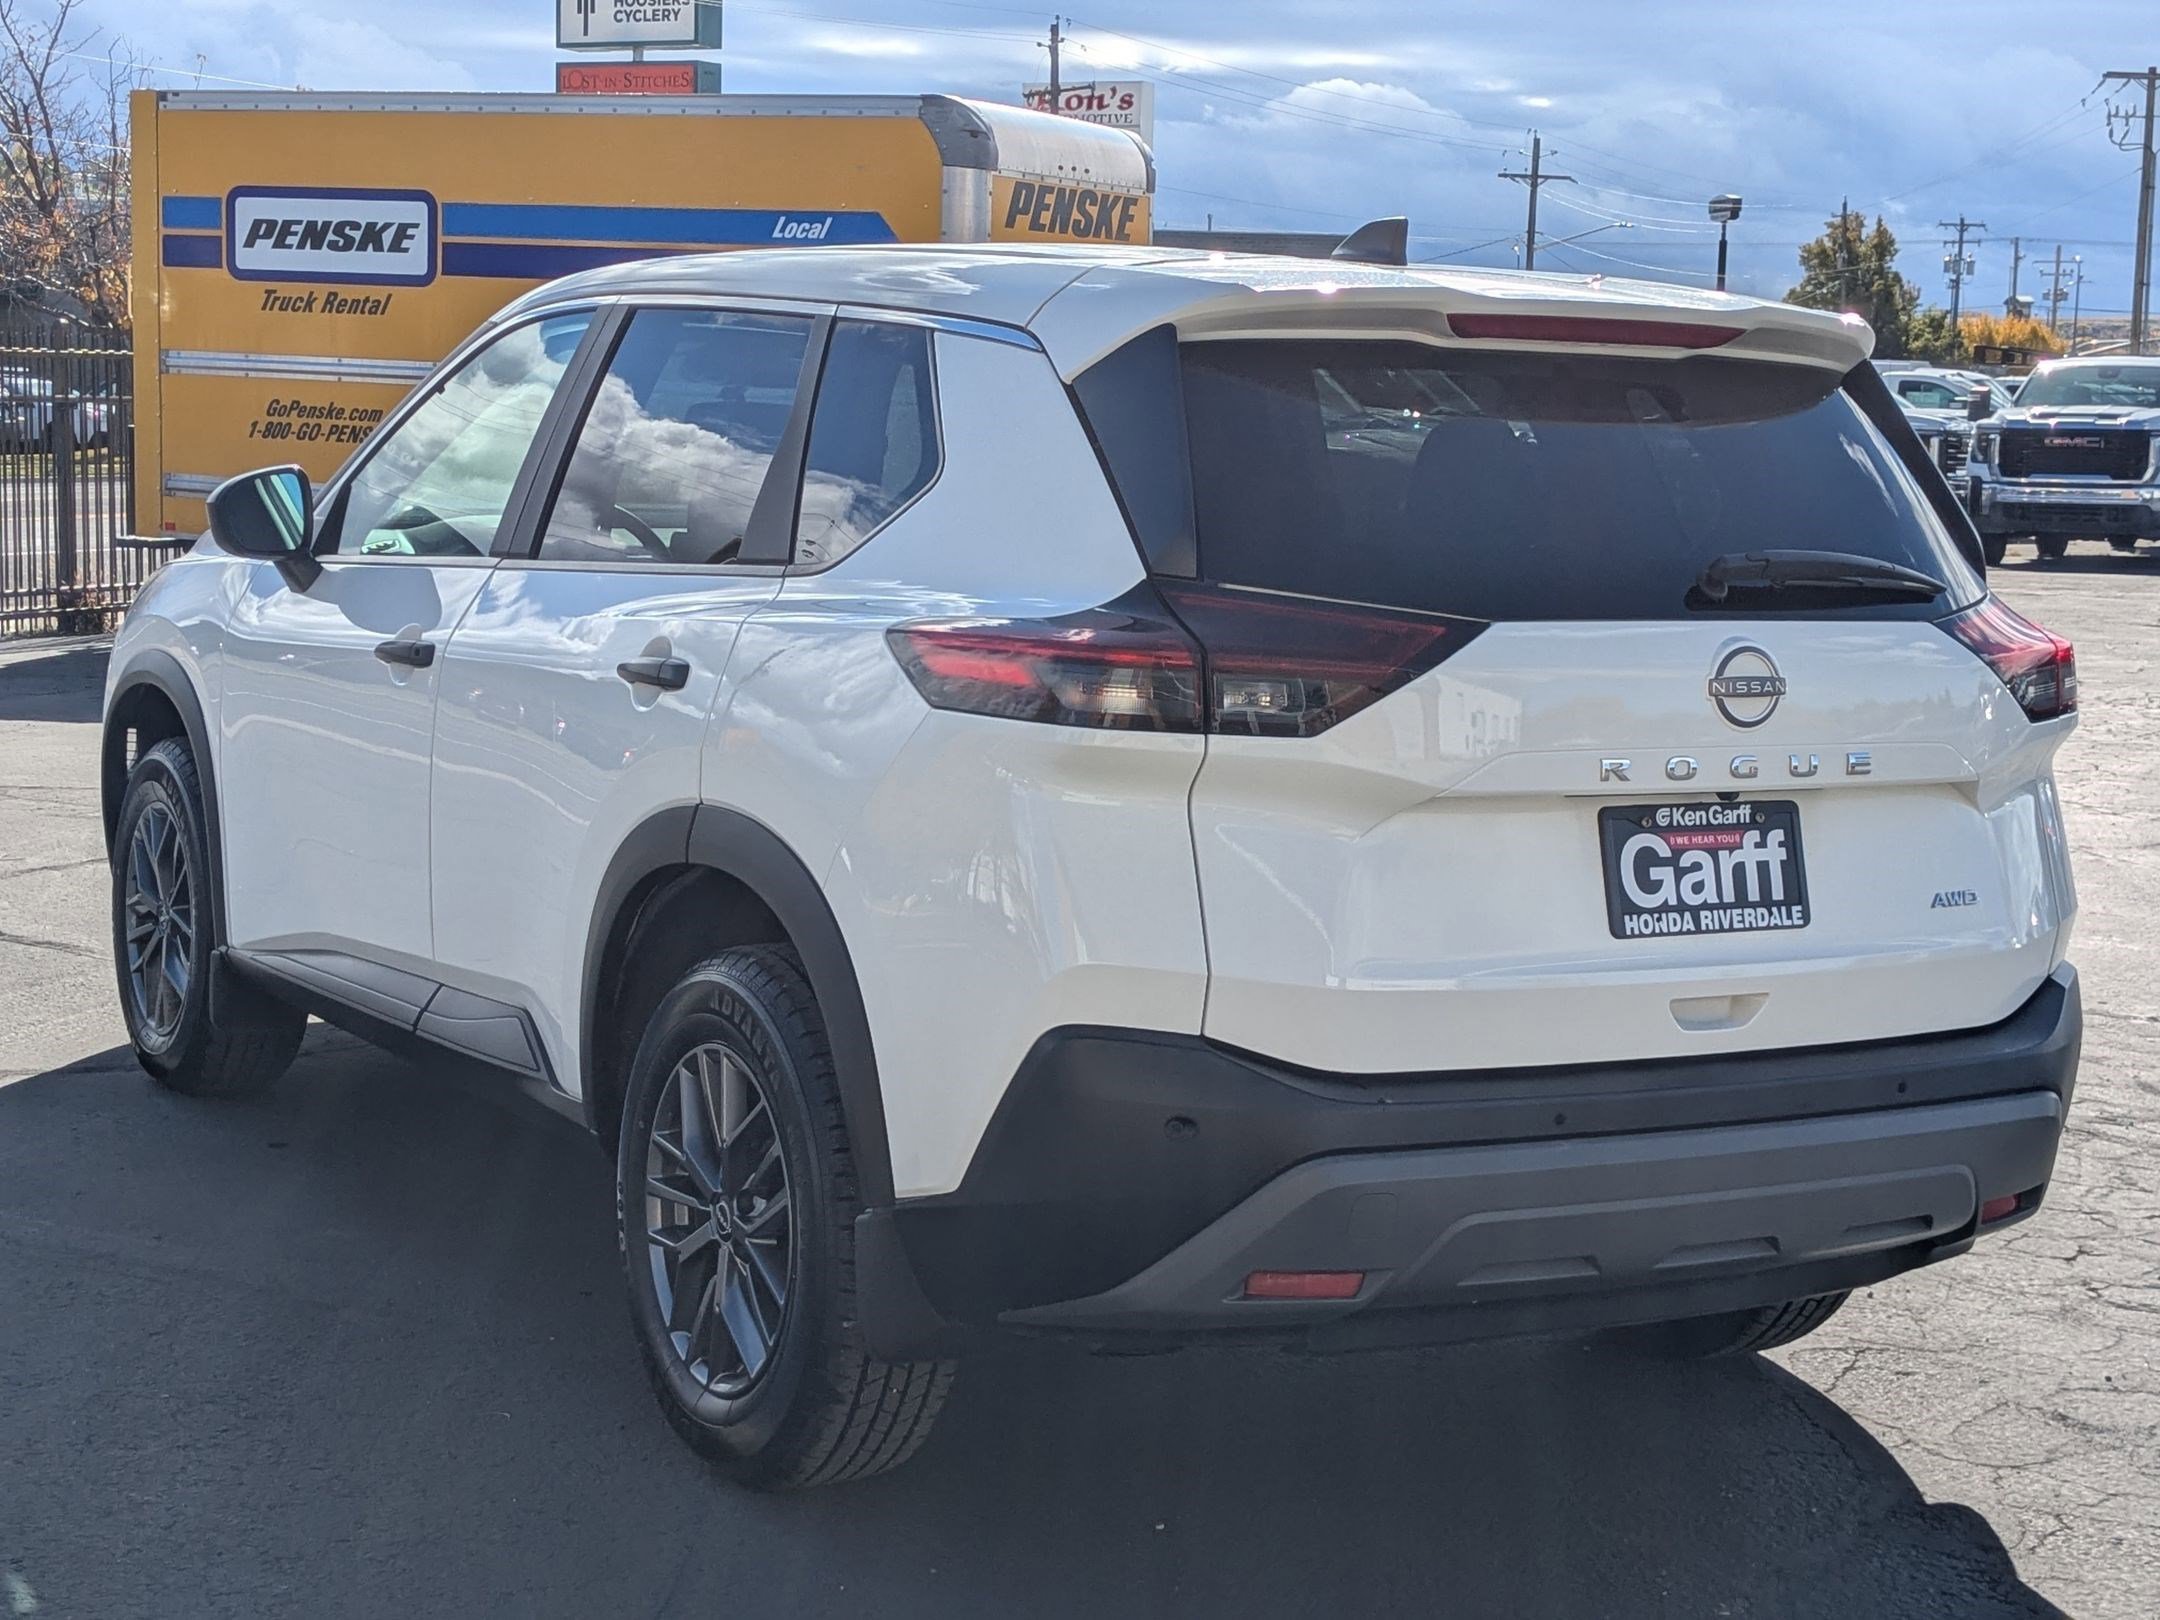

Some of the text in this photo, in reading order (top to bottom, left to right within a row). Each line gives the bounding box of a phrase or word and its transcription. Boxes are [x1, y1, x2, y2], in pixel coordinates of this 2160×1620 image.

[613, 8, 681, 23] CYCLERY
[1005, 181, 1139, 241] PENSKE
[243, 218, 420, 253] PENSKE
[772, 216, 833, 239] Local
[261, 289, 393, 316] Truck Rental
[266, 399, 384, 422] GoPenske.com
[2044, 436, 2100, 448] GMC
[1712, 679, 1786, 695] NISSAN
[1600, 752, 1872, 782] ROGUE
[1672, 806, 1707, 826] Ken
[1708, 804, 1751, 825] Garff
[1676, 833, 1734, 845] WE HEAR YOU
[1620, 828, 1787, 909] Garff
[1930, 889, 1978, 910] AWD
[1624, 905, 1804, 936] HONDA RIVERDALE
